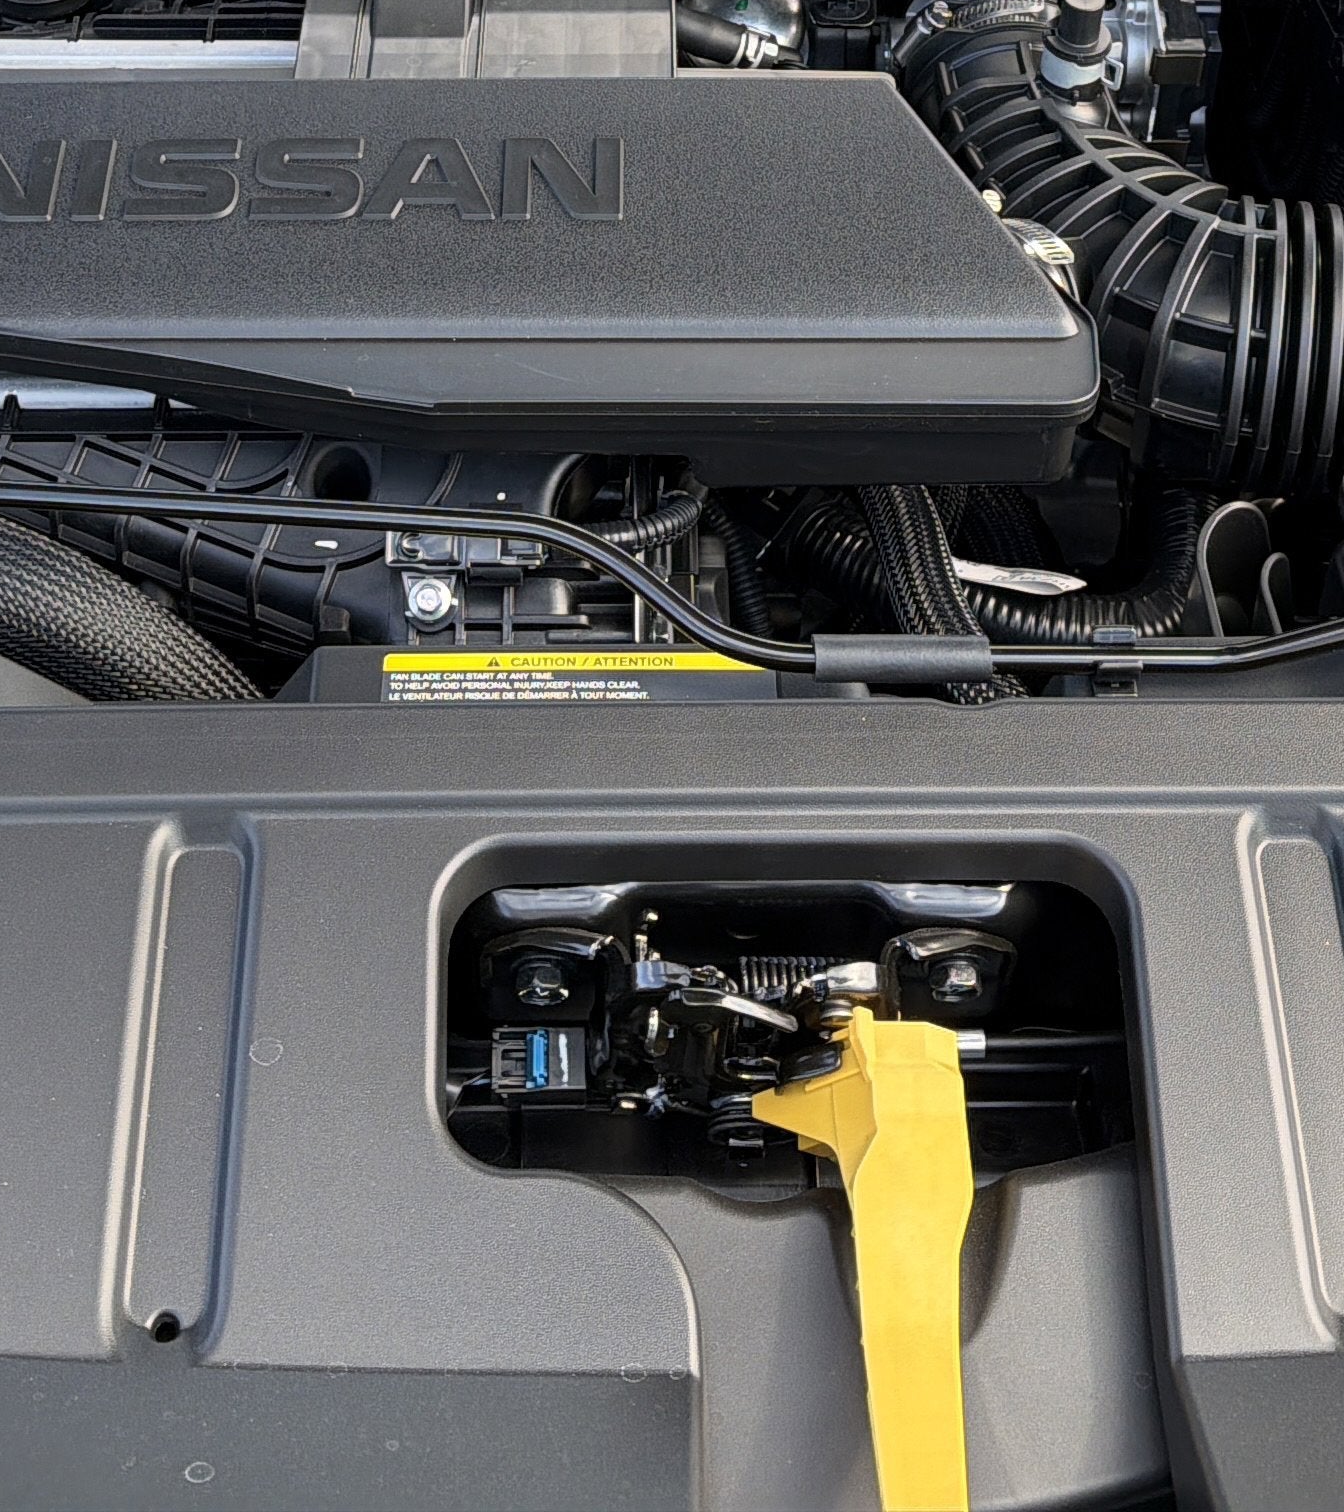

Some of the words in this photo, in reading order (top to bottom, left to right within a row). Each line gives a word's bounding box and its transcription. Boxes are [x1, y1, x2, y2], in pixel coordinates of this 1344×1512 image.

[510, 656, 576, 666] CAUTION
[582, 656, 589, 666] /
[594, 656, 674, 666] ATTENTION
[466, 672, 495, 680] START
[496, 672, 508, 680] AT
[509, 672, 528, 680] ANY
[532, 672, 554, 680] TIME.
[389, 682, 404, 690] TO
[405, 682, 430, 690] HELP
[431, 682, 460, 690] AVOID
[462, 682, 512, 690] PERSONAL
[572, 681, 606, 689] HANDS
[389, 692, 400, 700] LE
[402, 692, 464, 701] VENTILATEUR
[464, 691, 500, 700] RISQUE
[502, 691, 516, 700] DE
[516, 690, 569, 700] DÉMARRER
[570, 689, 578, 700] À
[580, 691, 604, 700] TOUT
[606, 691, 650, 700] MOMENT.
